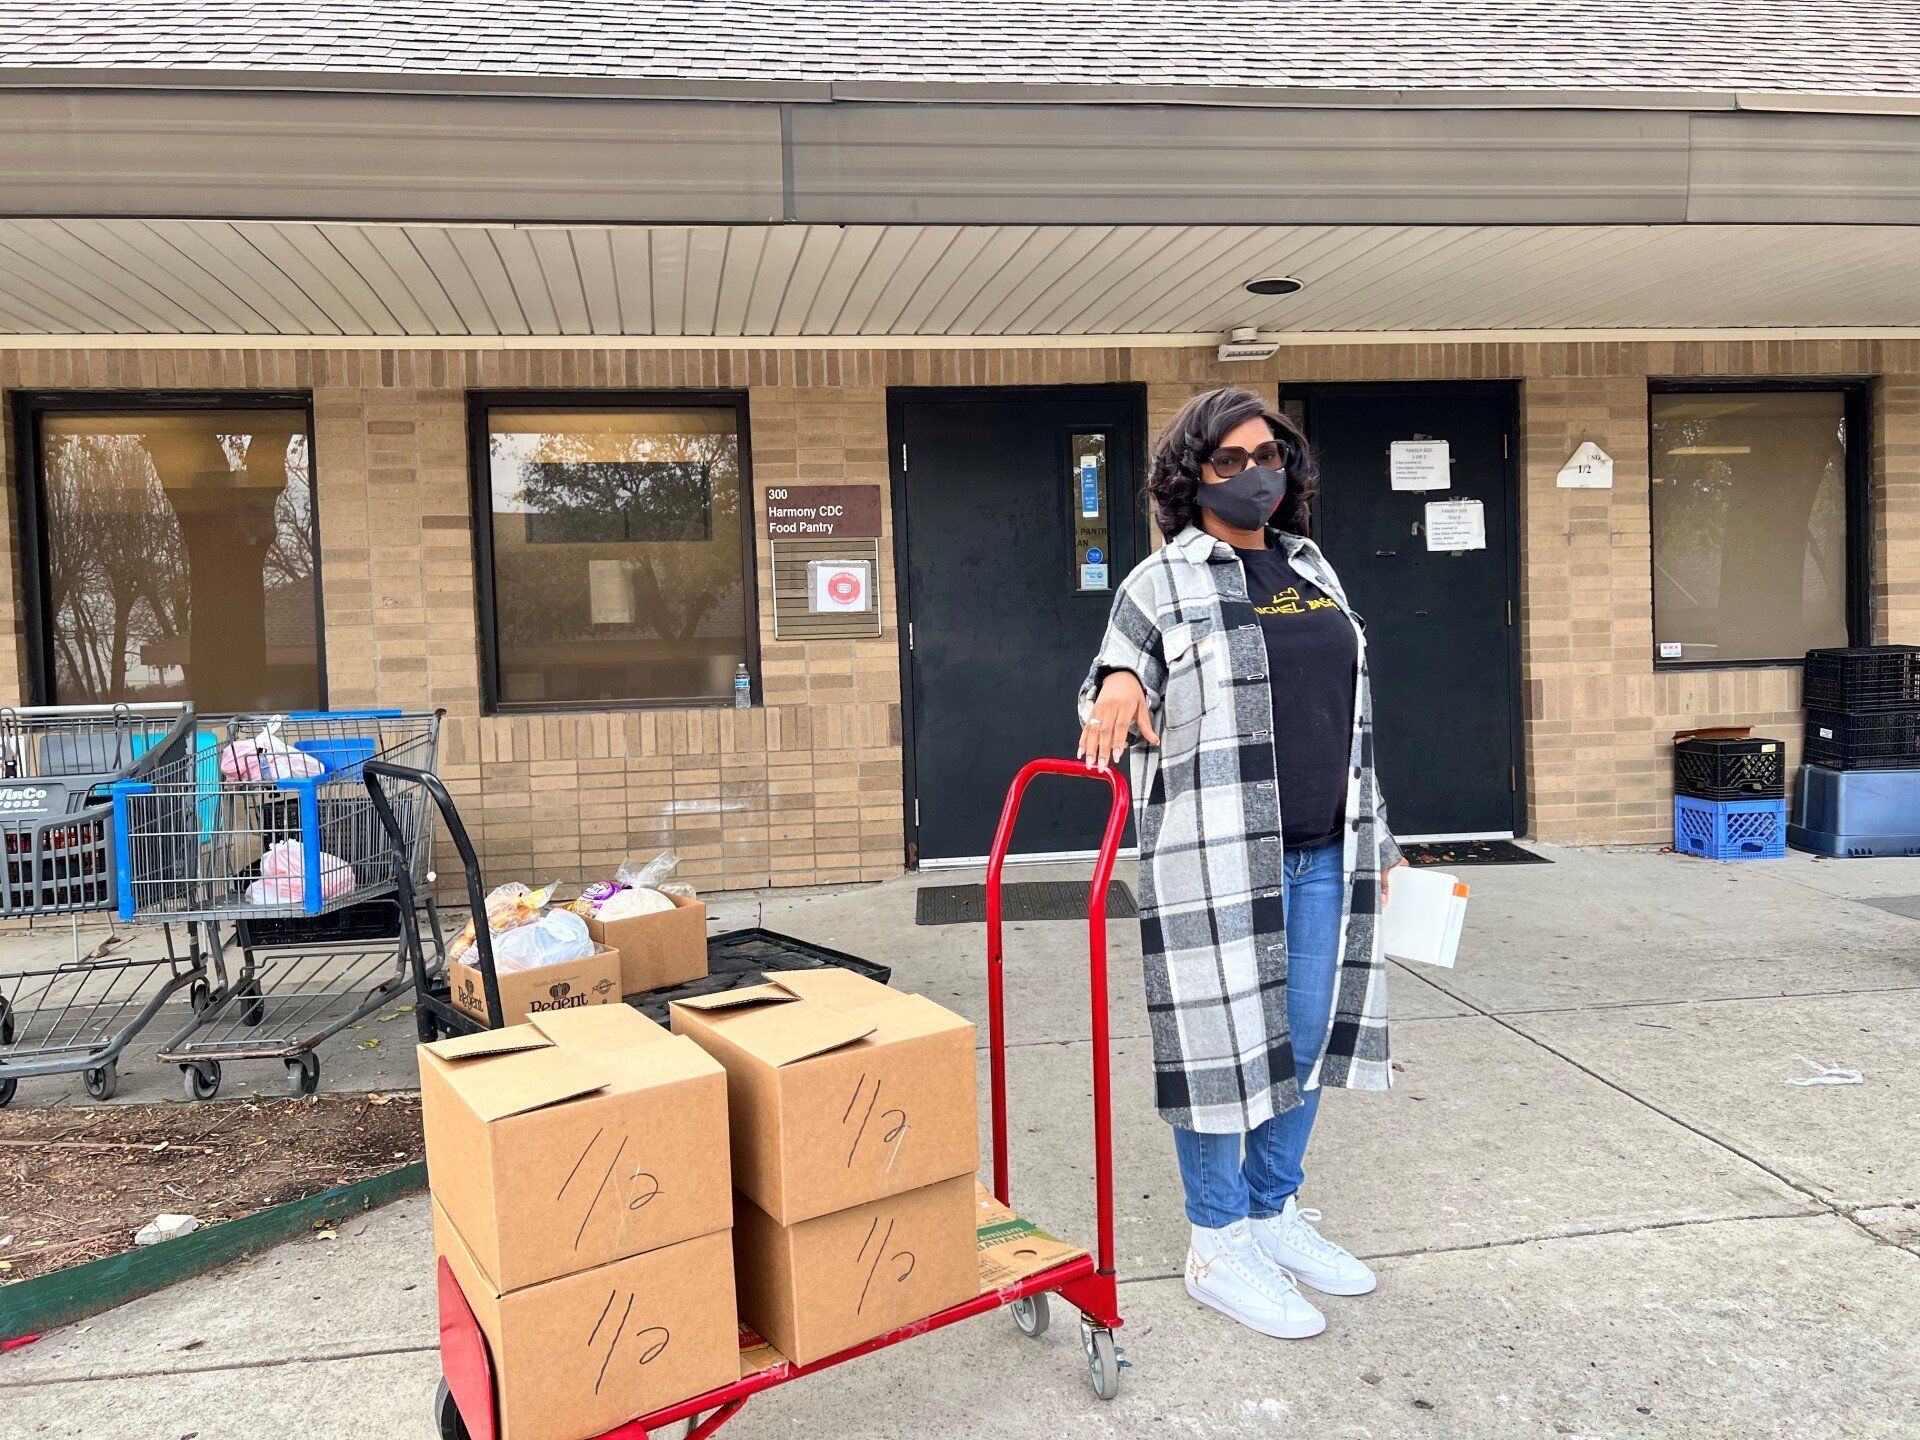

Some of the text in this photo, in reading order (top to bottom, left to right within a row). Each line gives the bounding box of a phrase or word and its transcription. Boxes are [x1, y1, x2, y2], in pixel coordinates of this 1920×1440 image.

[1578, 465, 1592, 474] 1/2
[768, 489, 788, 500] 300
[768, 505, 843, 519] Harmony CDC
[769, 521, 833, 534] Food Pantry
